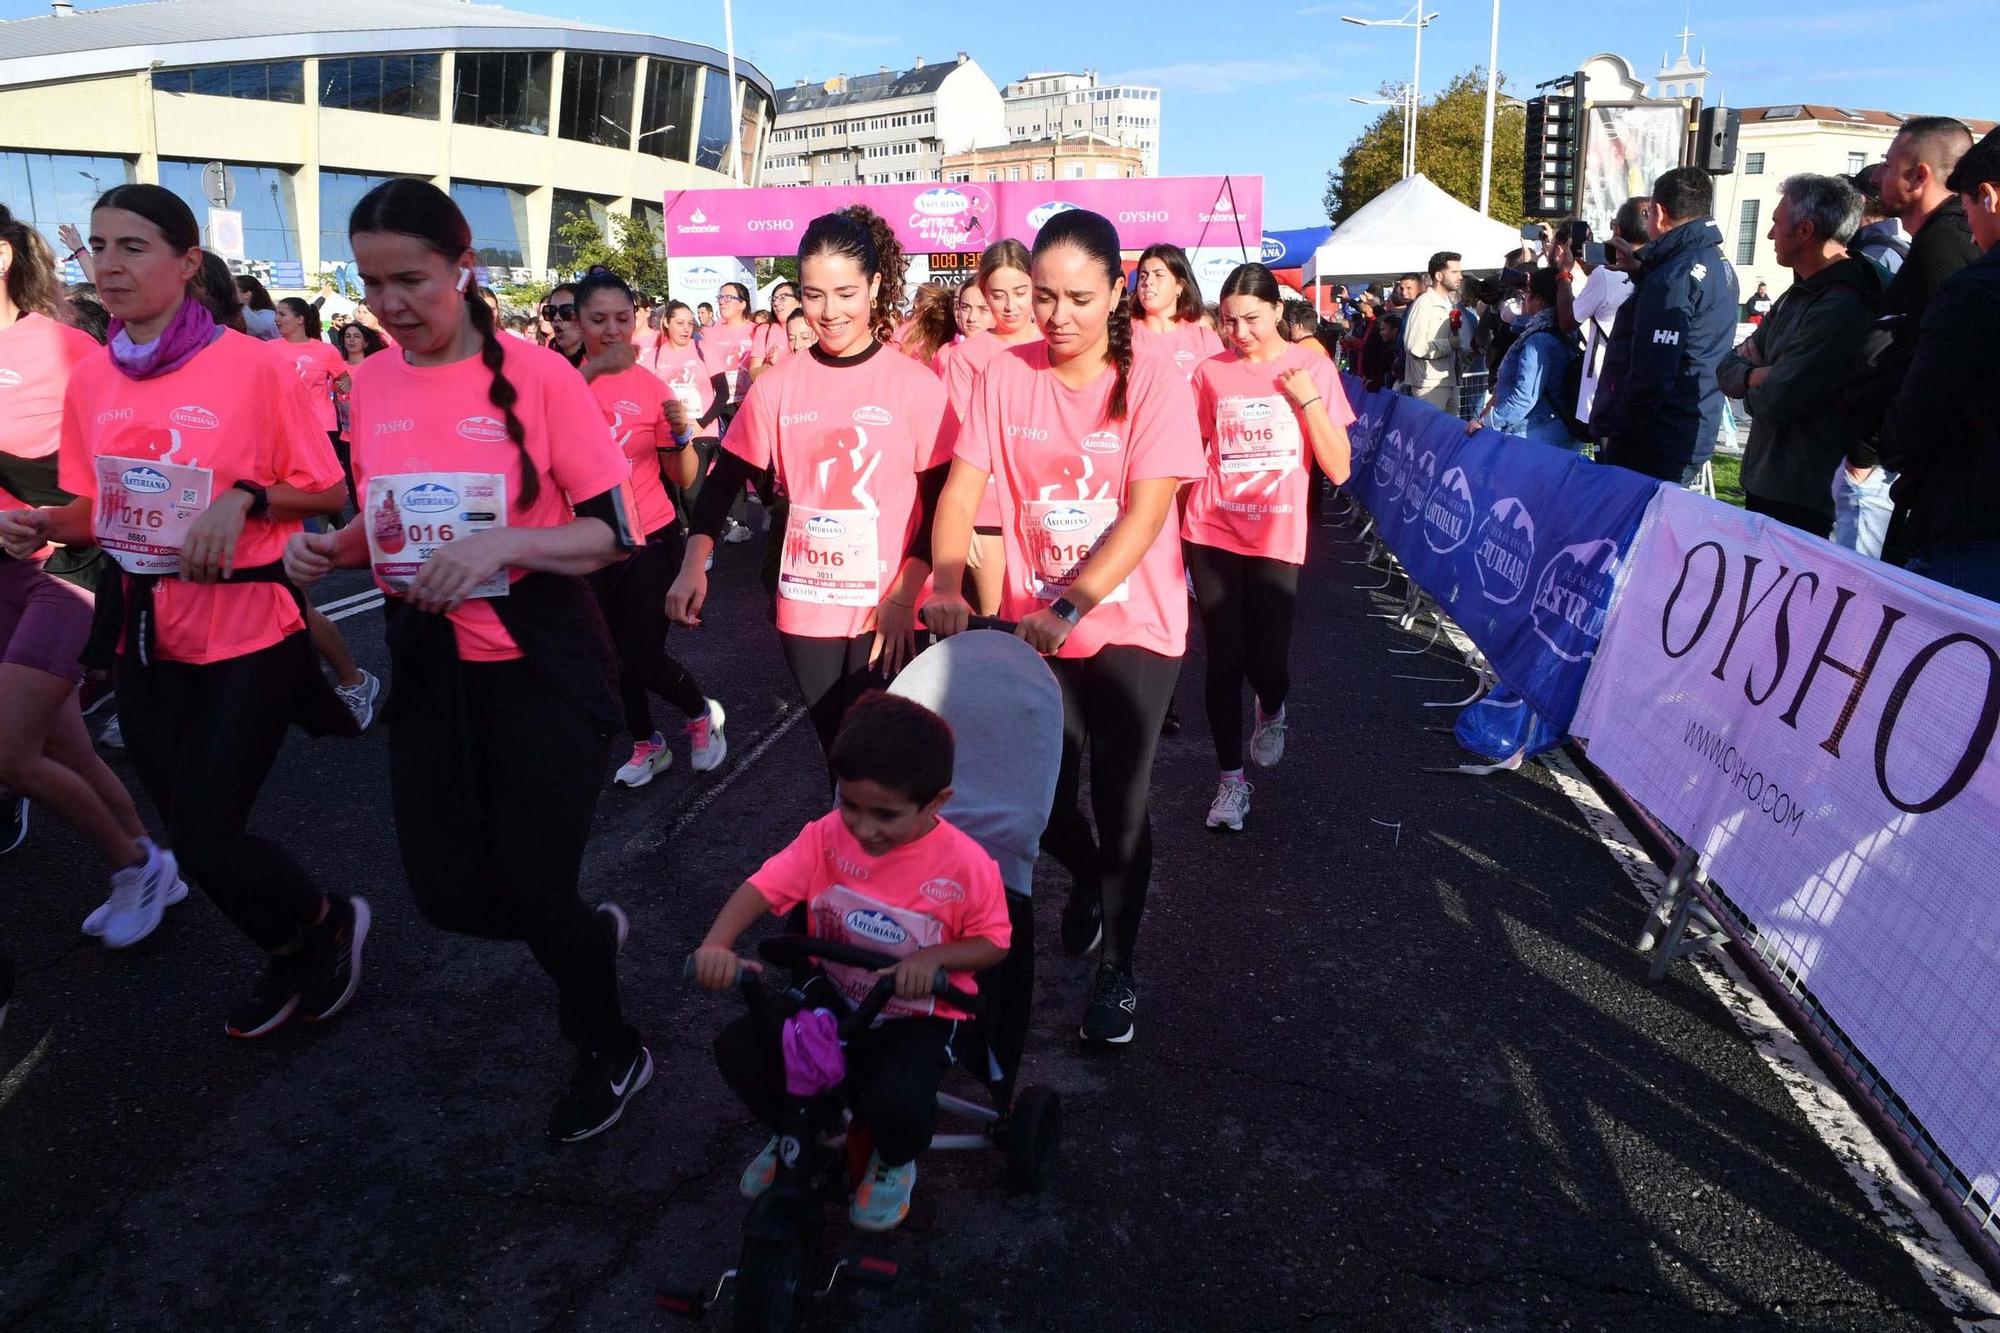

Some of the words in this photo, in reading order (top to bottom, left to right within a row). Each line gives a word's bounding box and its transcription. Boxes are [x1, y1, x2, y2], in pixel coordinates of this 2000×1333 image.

[747, 219, 794, 232] OYSHO
[1119, 211, 1169, 223] OYSHO
[1198, 212, 1247, 222] Santander
[677, 224, 720, 234] Santander
[1653, 329, 1680, 346] HH
[1244, 428, 1274, 442] 016
[124, 474, 167, 490] ASTURIANA
[123, 505, 164, 529] 016
[408, 524, 454, 542] 016
[807, 550, 845, 567] 016
[1051, 544, 1090, 561] 016
[1662, 540, 2000, 815] OYSHO
[1683, 719, 1806, 838] WWW.OHO.COM
[849, 913, 901, 941] ASTURIANA
